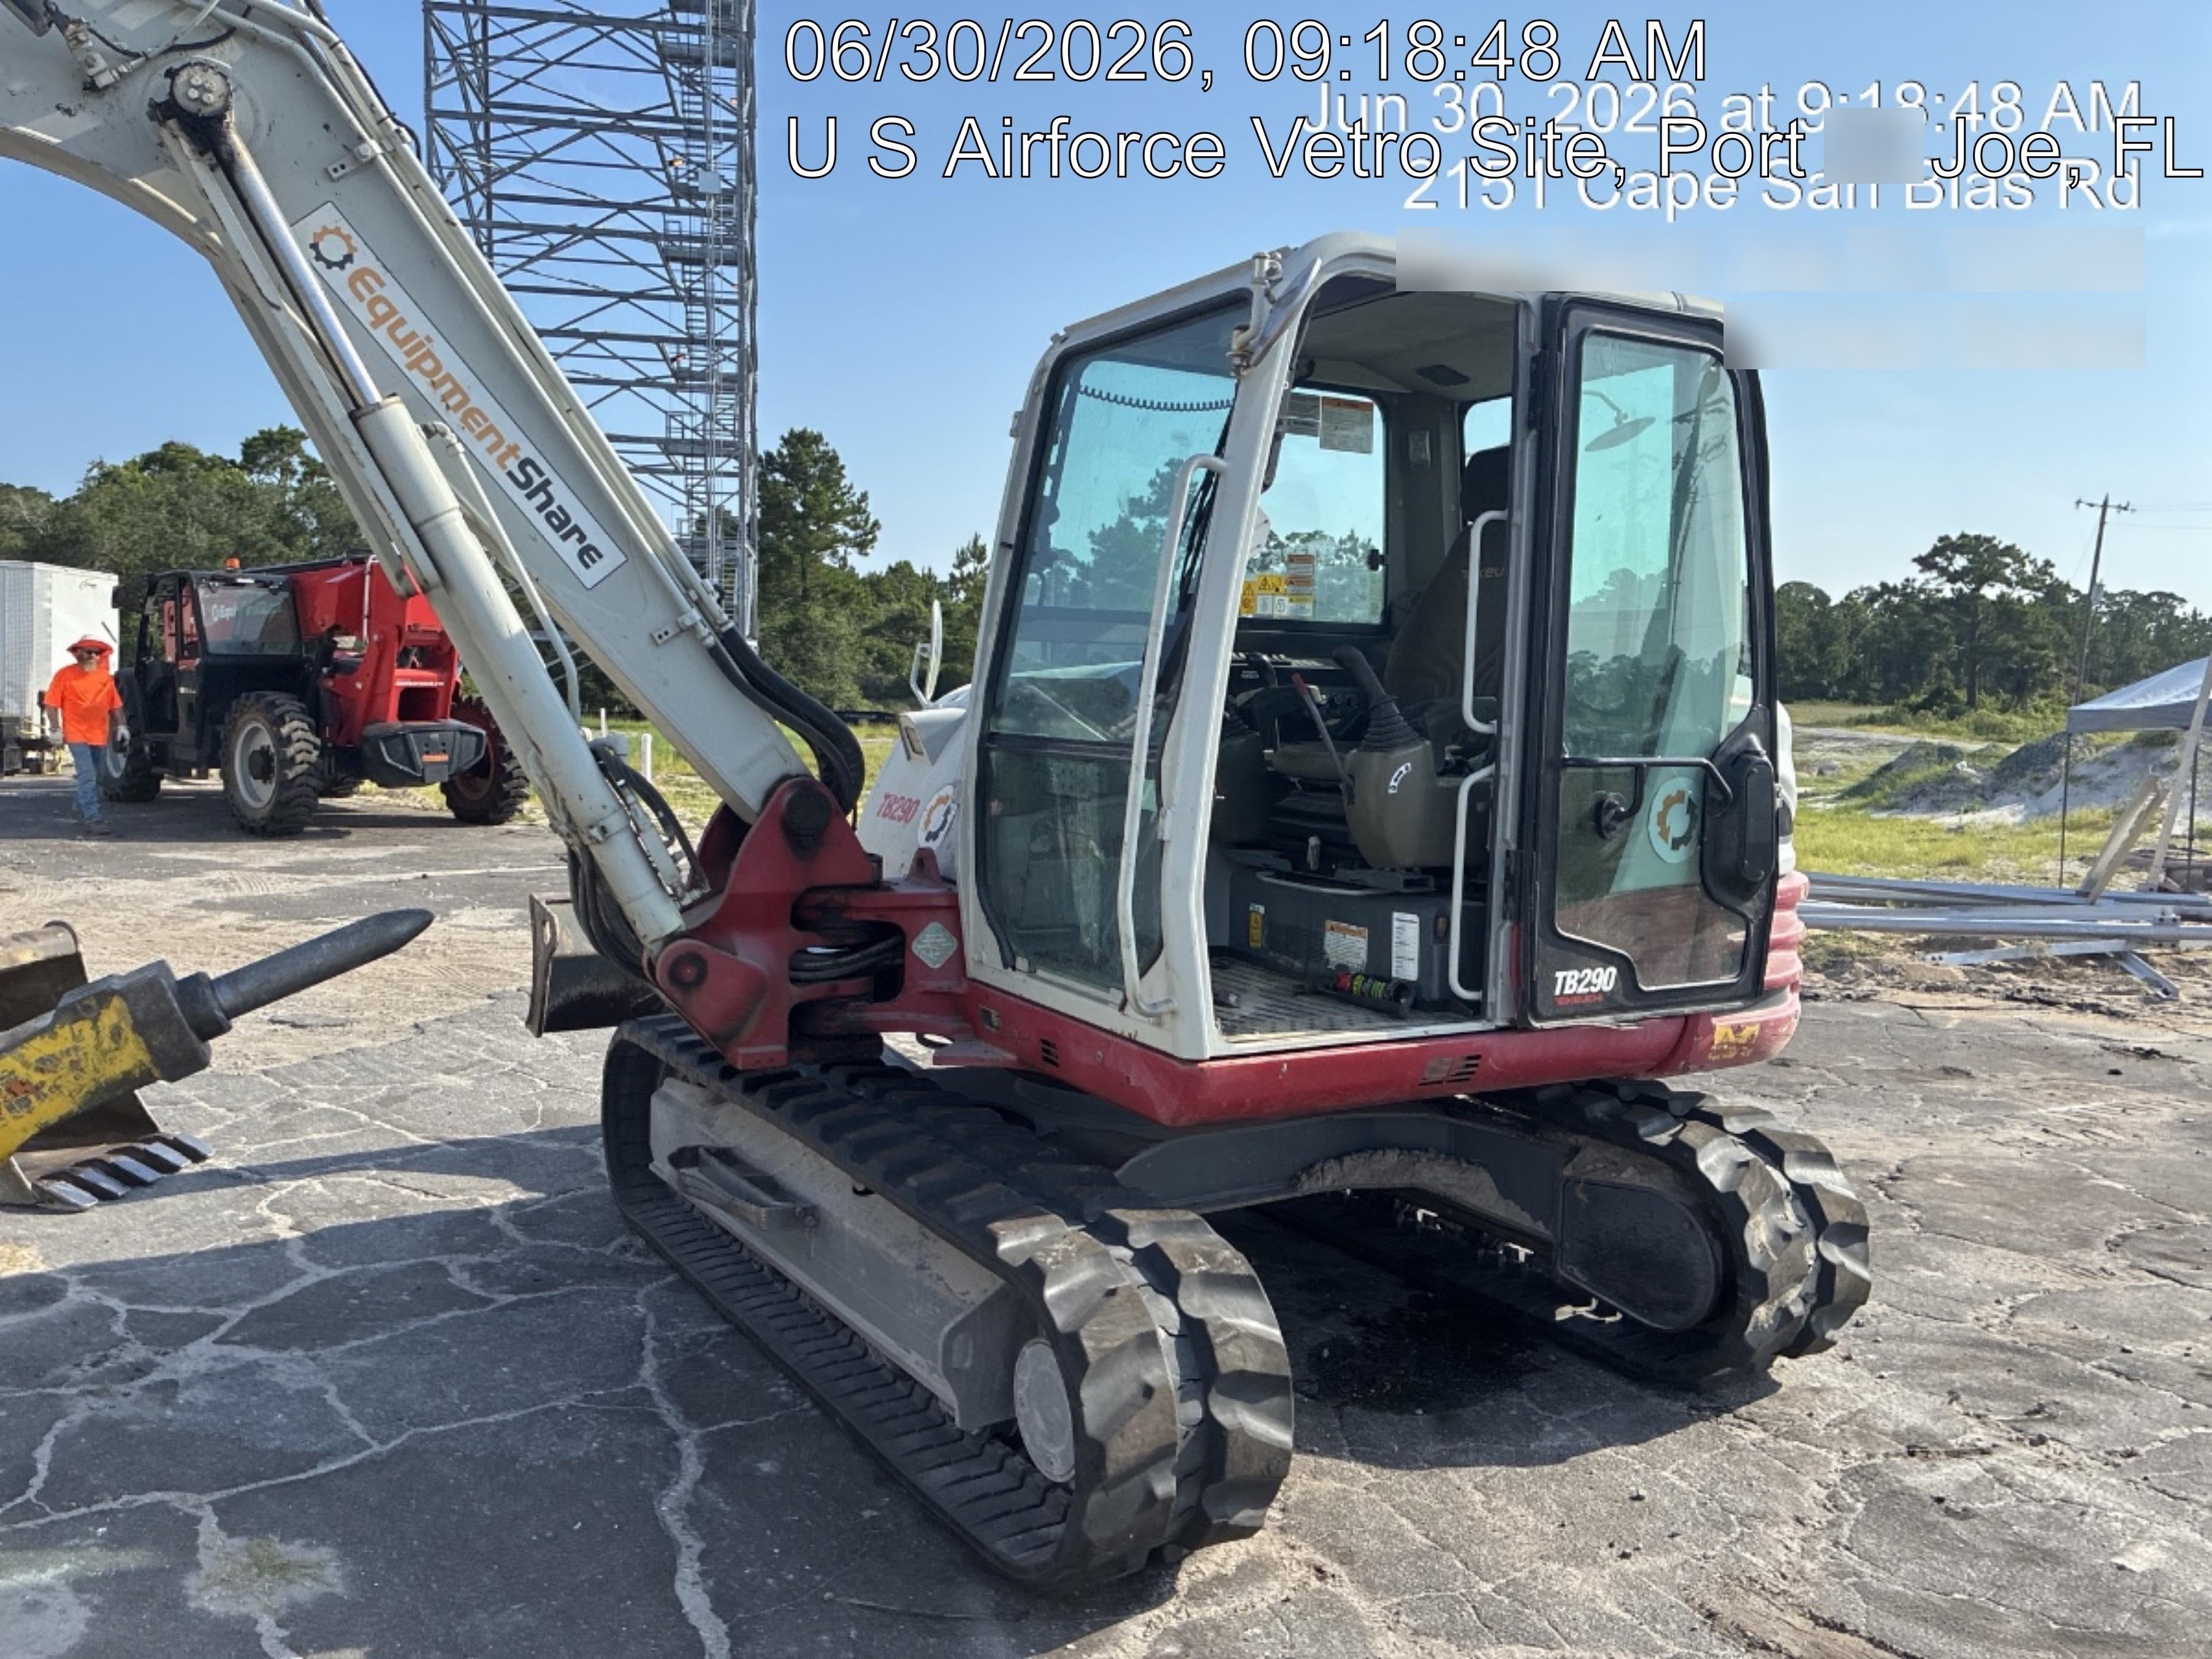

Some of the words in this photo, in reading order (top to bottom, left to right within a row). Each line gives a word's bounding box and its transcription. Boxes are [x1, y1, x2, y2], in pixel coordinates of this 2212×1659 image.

[347, 266, 603, 570] EquipmentShare
[877, 793, 920, 823] TB290
[1553, 965, 1617, 995] TB290
